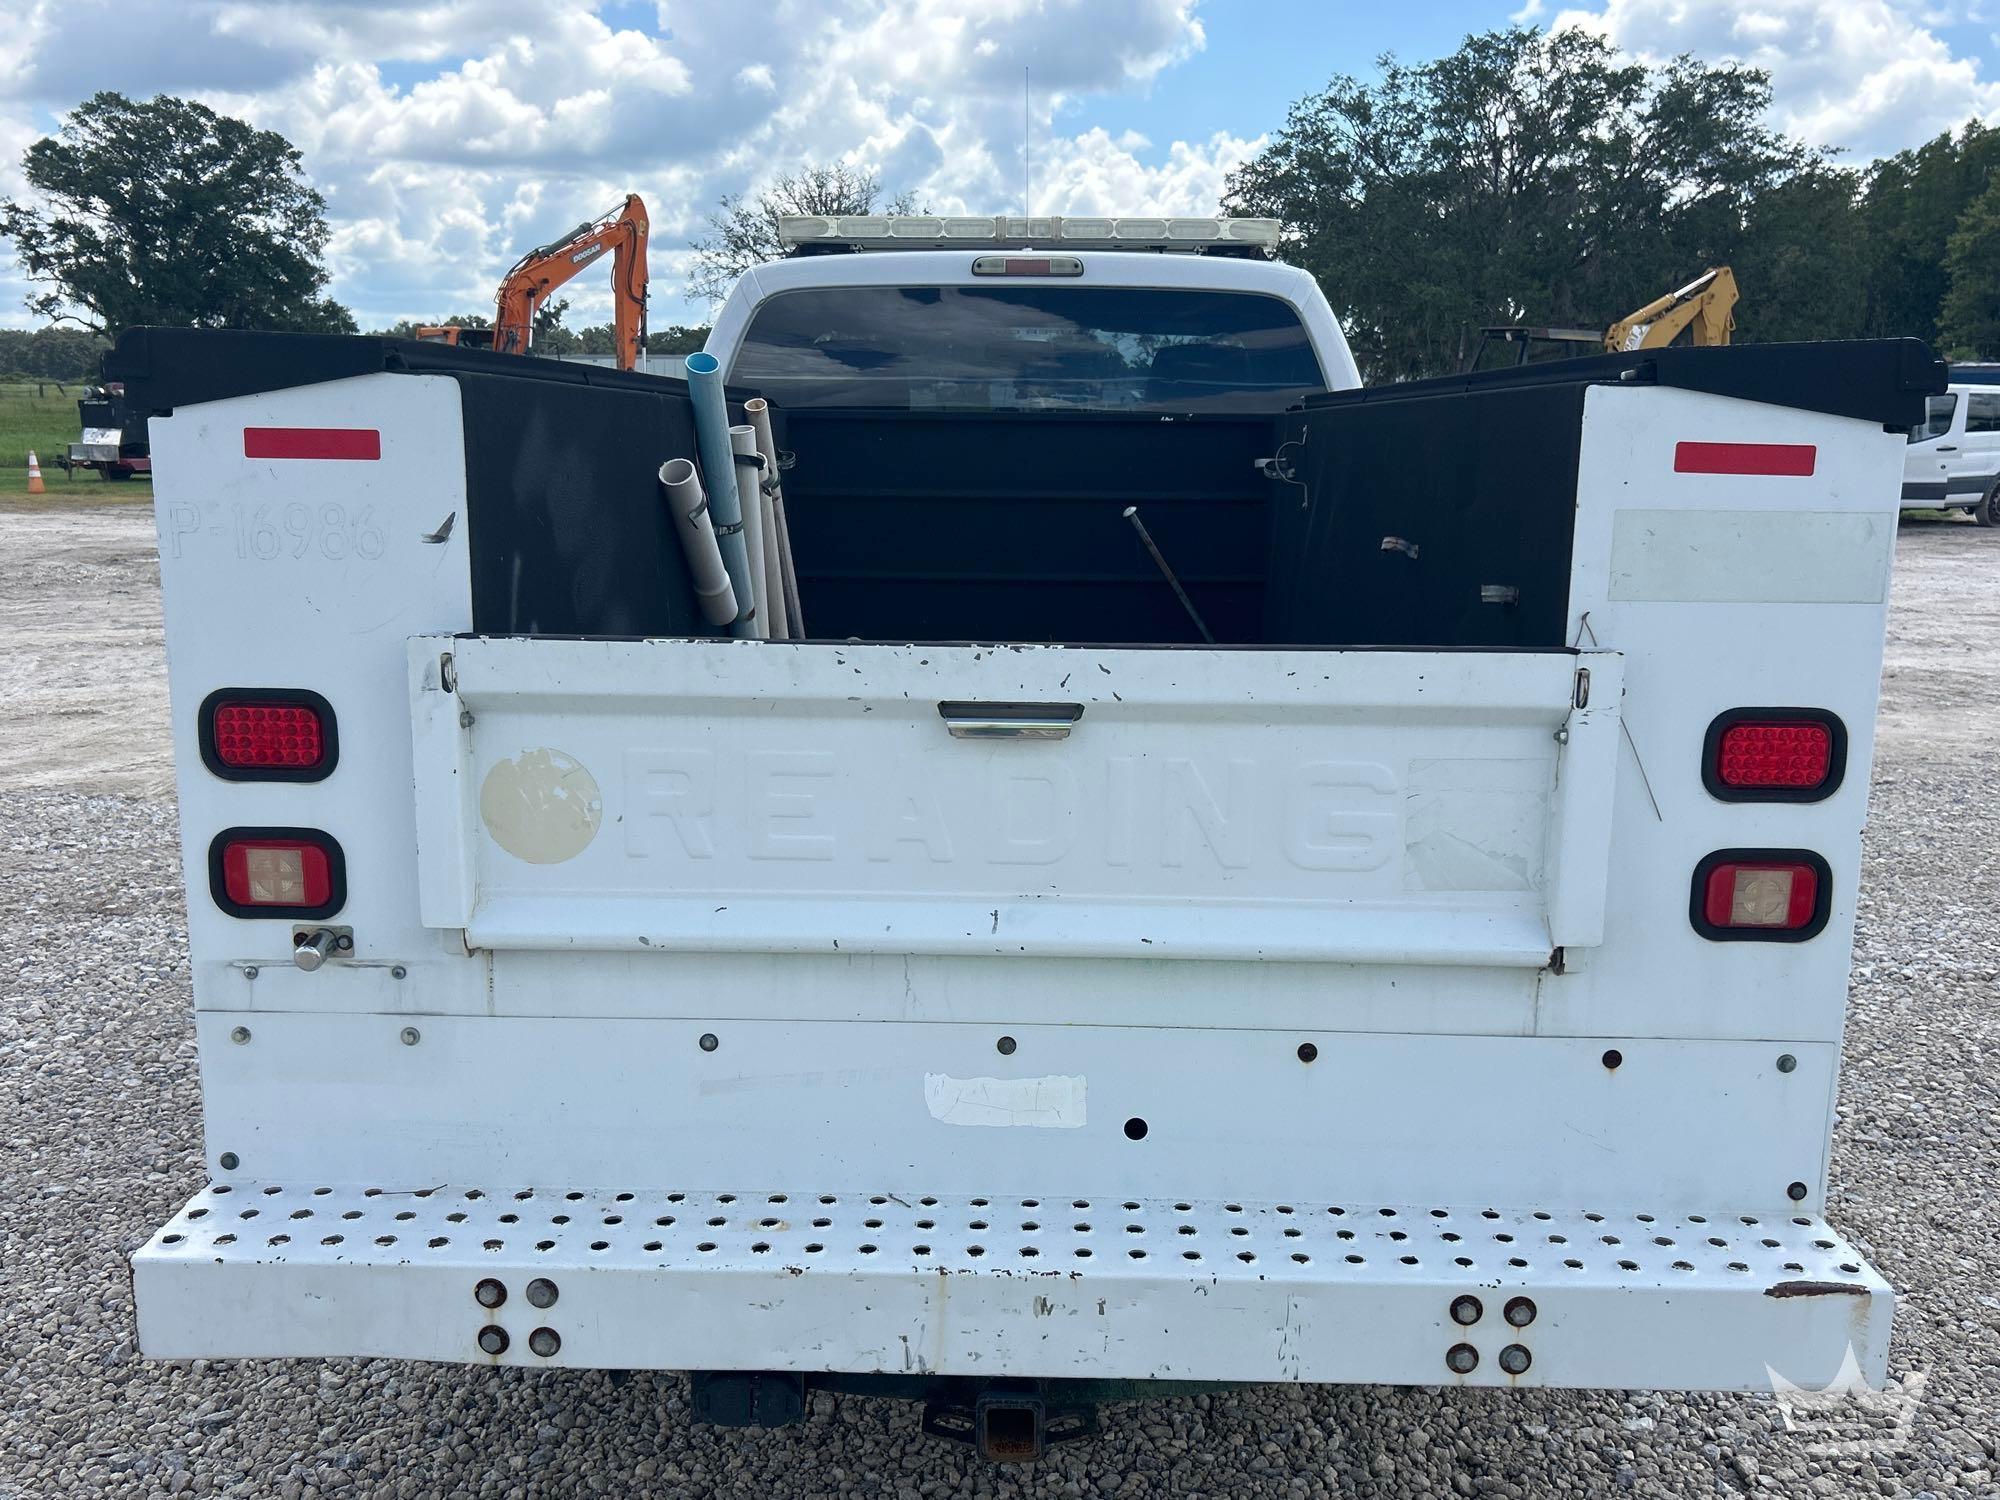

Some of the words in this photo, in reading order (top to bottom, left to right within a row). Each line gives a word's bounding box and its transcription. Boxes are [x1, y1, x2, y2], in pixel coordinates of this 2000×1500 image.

[573, 243, 600, 263] DOOSAN
[168, 502, 384, 560] P-16986
[622, 747, 1398, 873] READING
